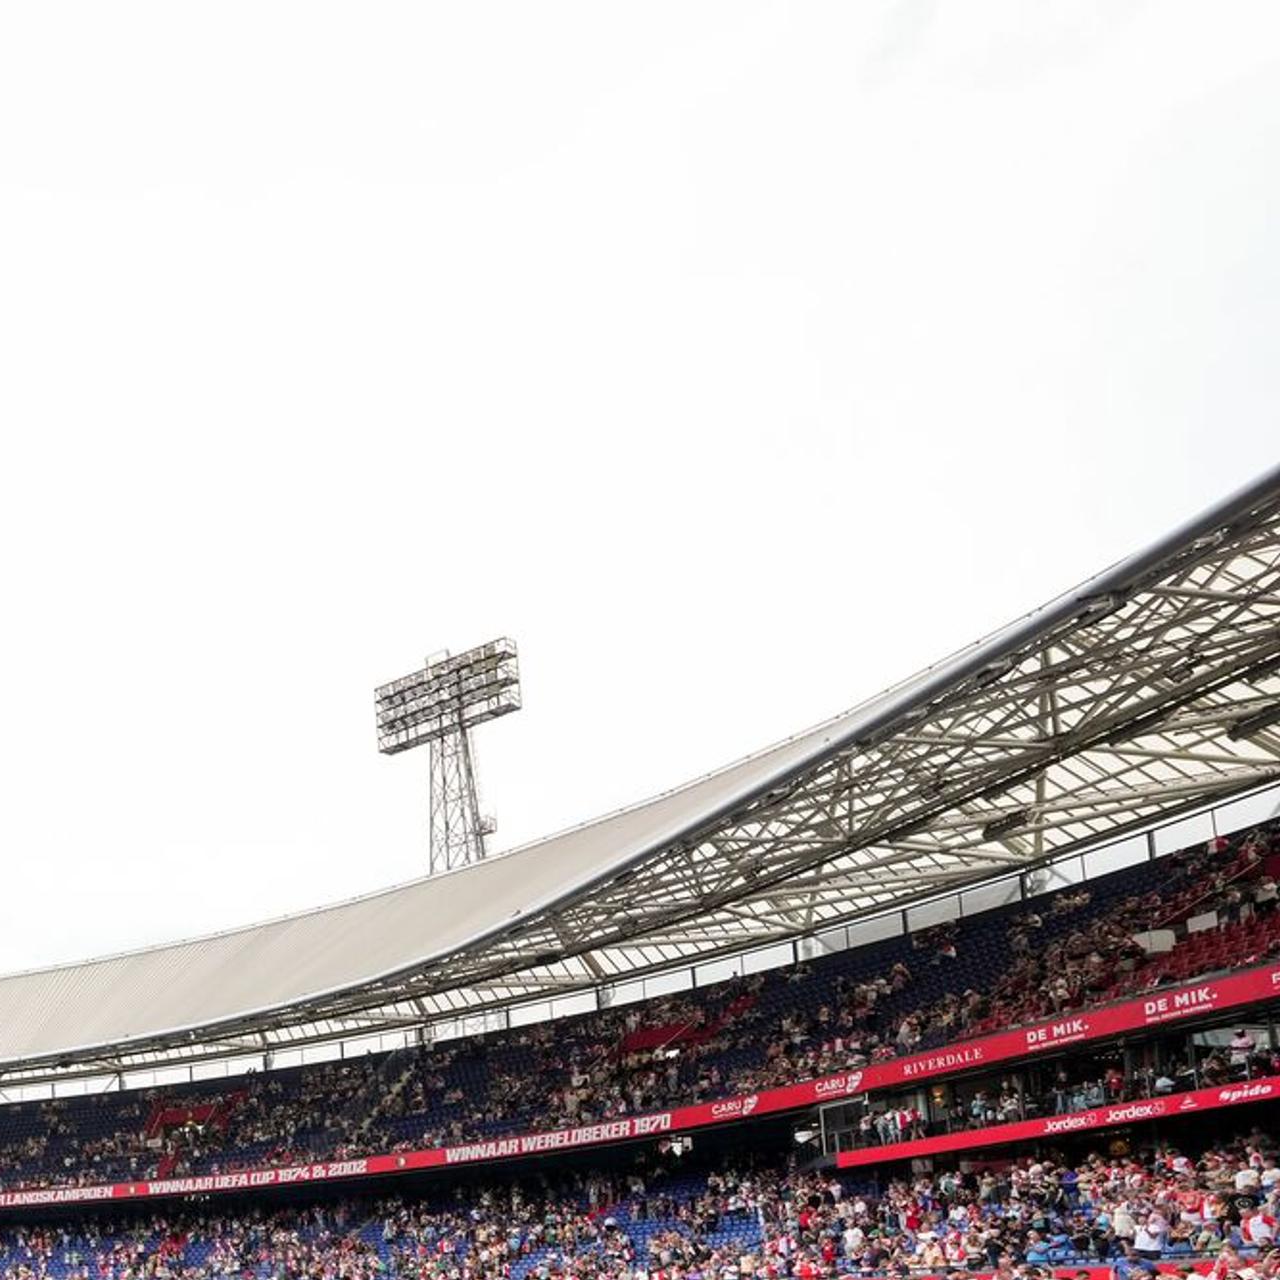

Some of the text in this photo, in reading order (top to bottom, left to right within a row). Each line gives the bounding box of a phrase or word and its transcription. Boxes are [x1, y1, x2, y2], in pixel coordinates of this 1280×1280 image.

[1144, 999, 1168, 1015] DE
[1027, 1029, 1047, 1043] DE
[903, 1047, 984, 1076] RIVERDALE
[445, 1113, 671, 1163] WINNAAR WERELDBEKER 1970
[148, 1177, 215, 1195] WINNAAR
[214, 1173, 248, 1190] UEFA
[250, 1171, 275, 1186] CUP
